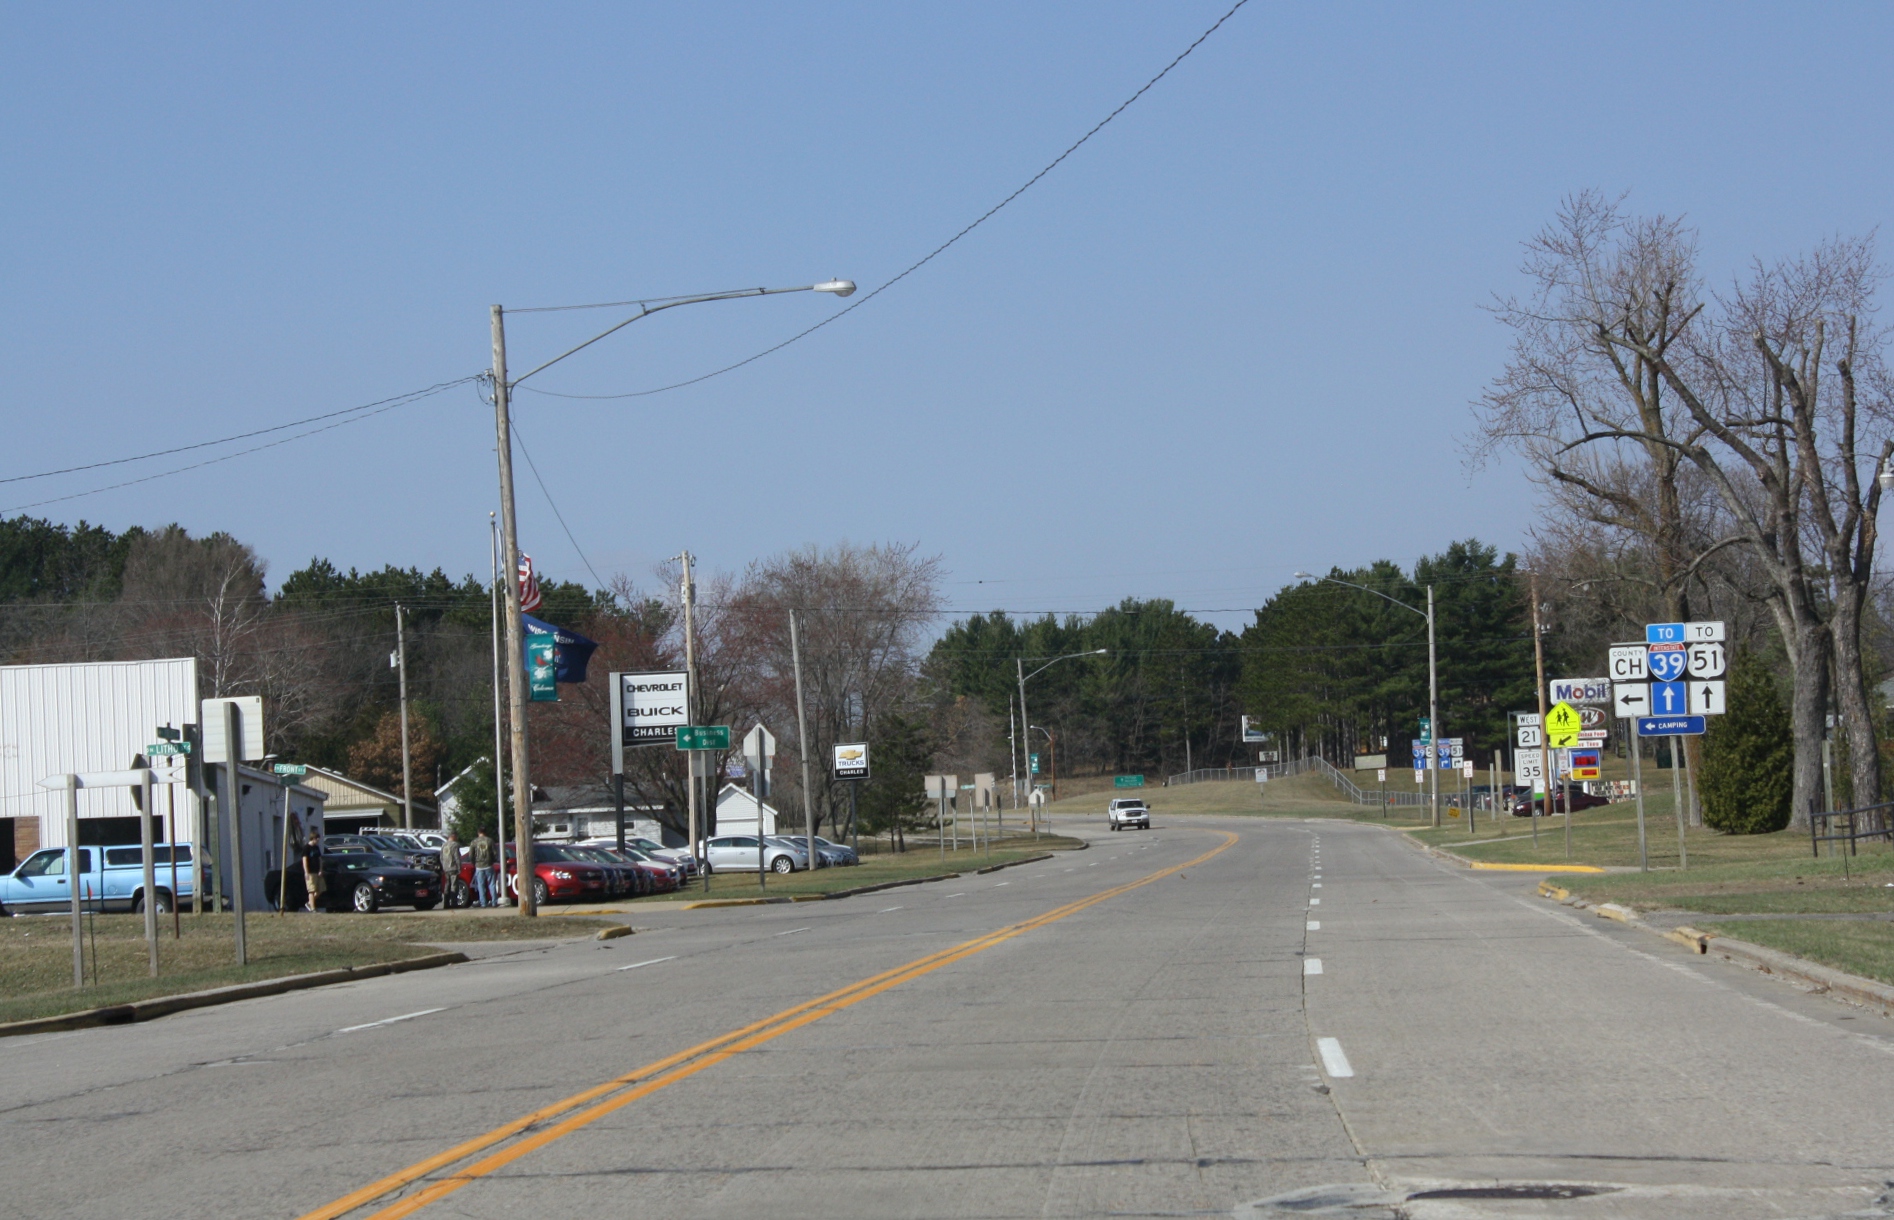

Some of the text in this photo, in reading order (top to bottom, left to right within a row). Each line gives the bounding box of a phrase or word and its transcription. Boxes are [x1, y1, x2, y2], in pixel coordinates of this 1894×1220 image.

[1657, 628, 1674, 640] TO
[1695, 626, 1714, 637] TO
[1612, 649, 1643, 657] COUNTY
[1615, 657, 1642, 675] CH
[1653, 653, 1683, 675] 39
[1694, 650, 1718, 671] 51
[626, 682, 683, 693] CHEVROLET
[1556, 684, 1606, 700] Mobil
[627, 706, 684, 717] BUICK
[1519, 716, 1538, 724] WEST
[1658, 721, 1688, 729] CAMPING
[1521, 730, 1536, 743] 21
[156, 744, 178, 754] LITHO
[1414, 749, 1425, 757] 39
[1439, 748, 1450, 757] 39
[1452, 747, 1461, 755] 51
[280, 765, 297, 773] FRONT
[1523, 766, 1541, 777] 35
